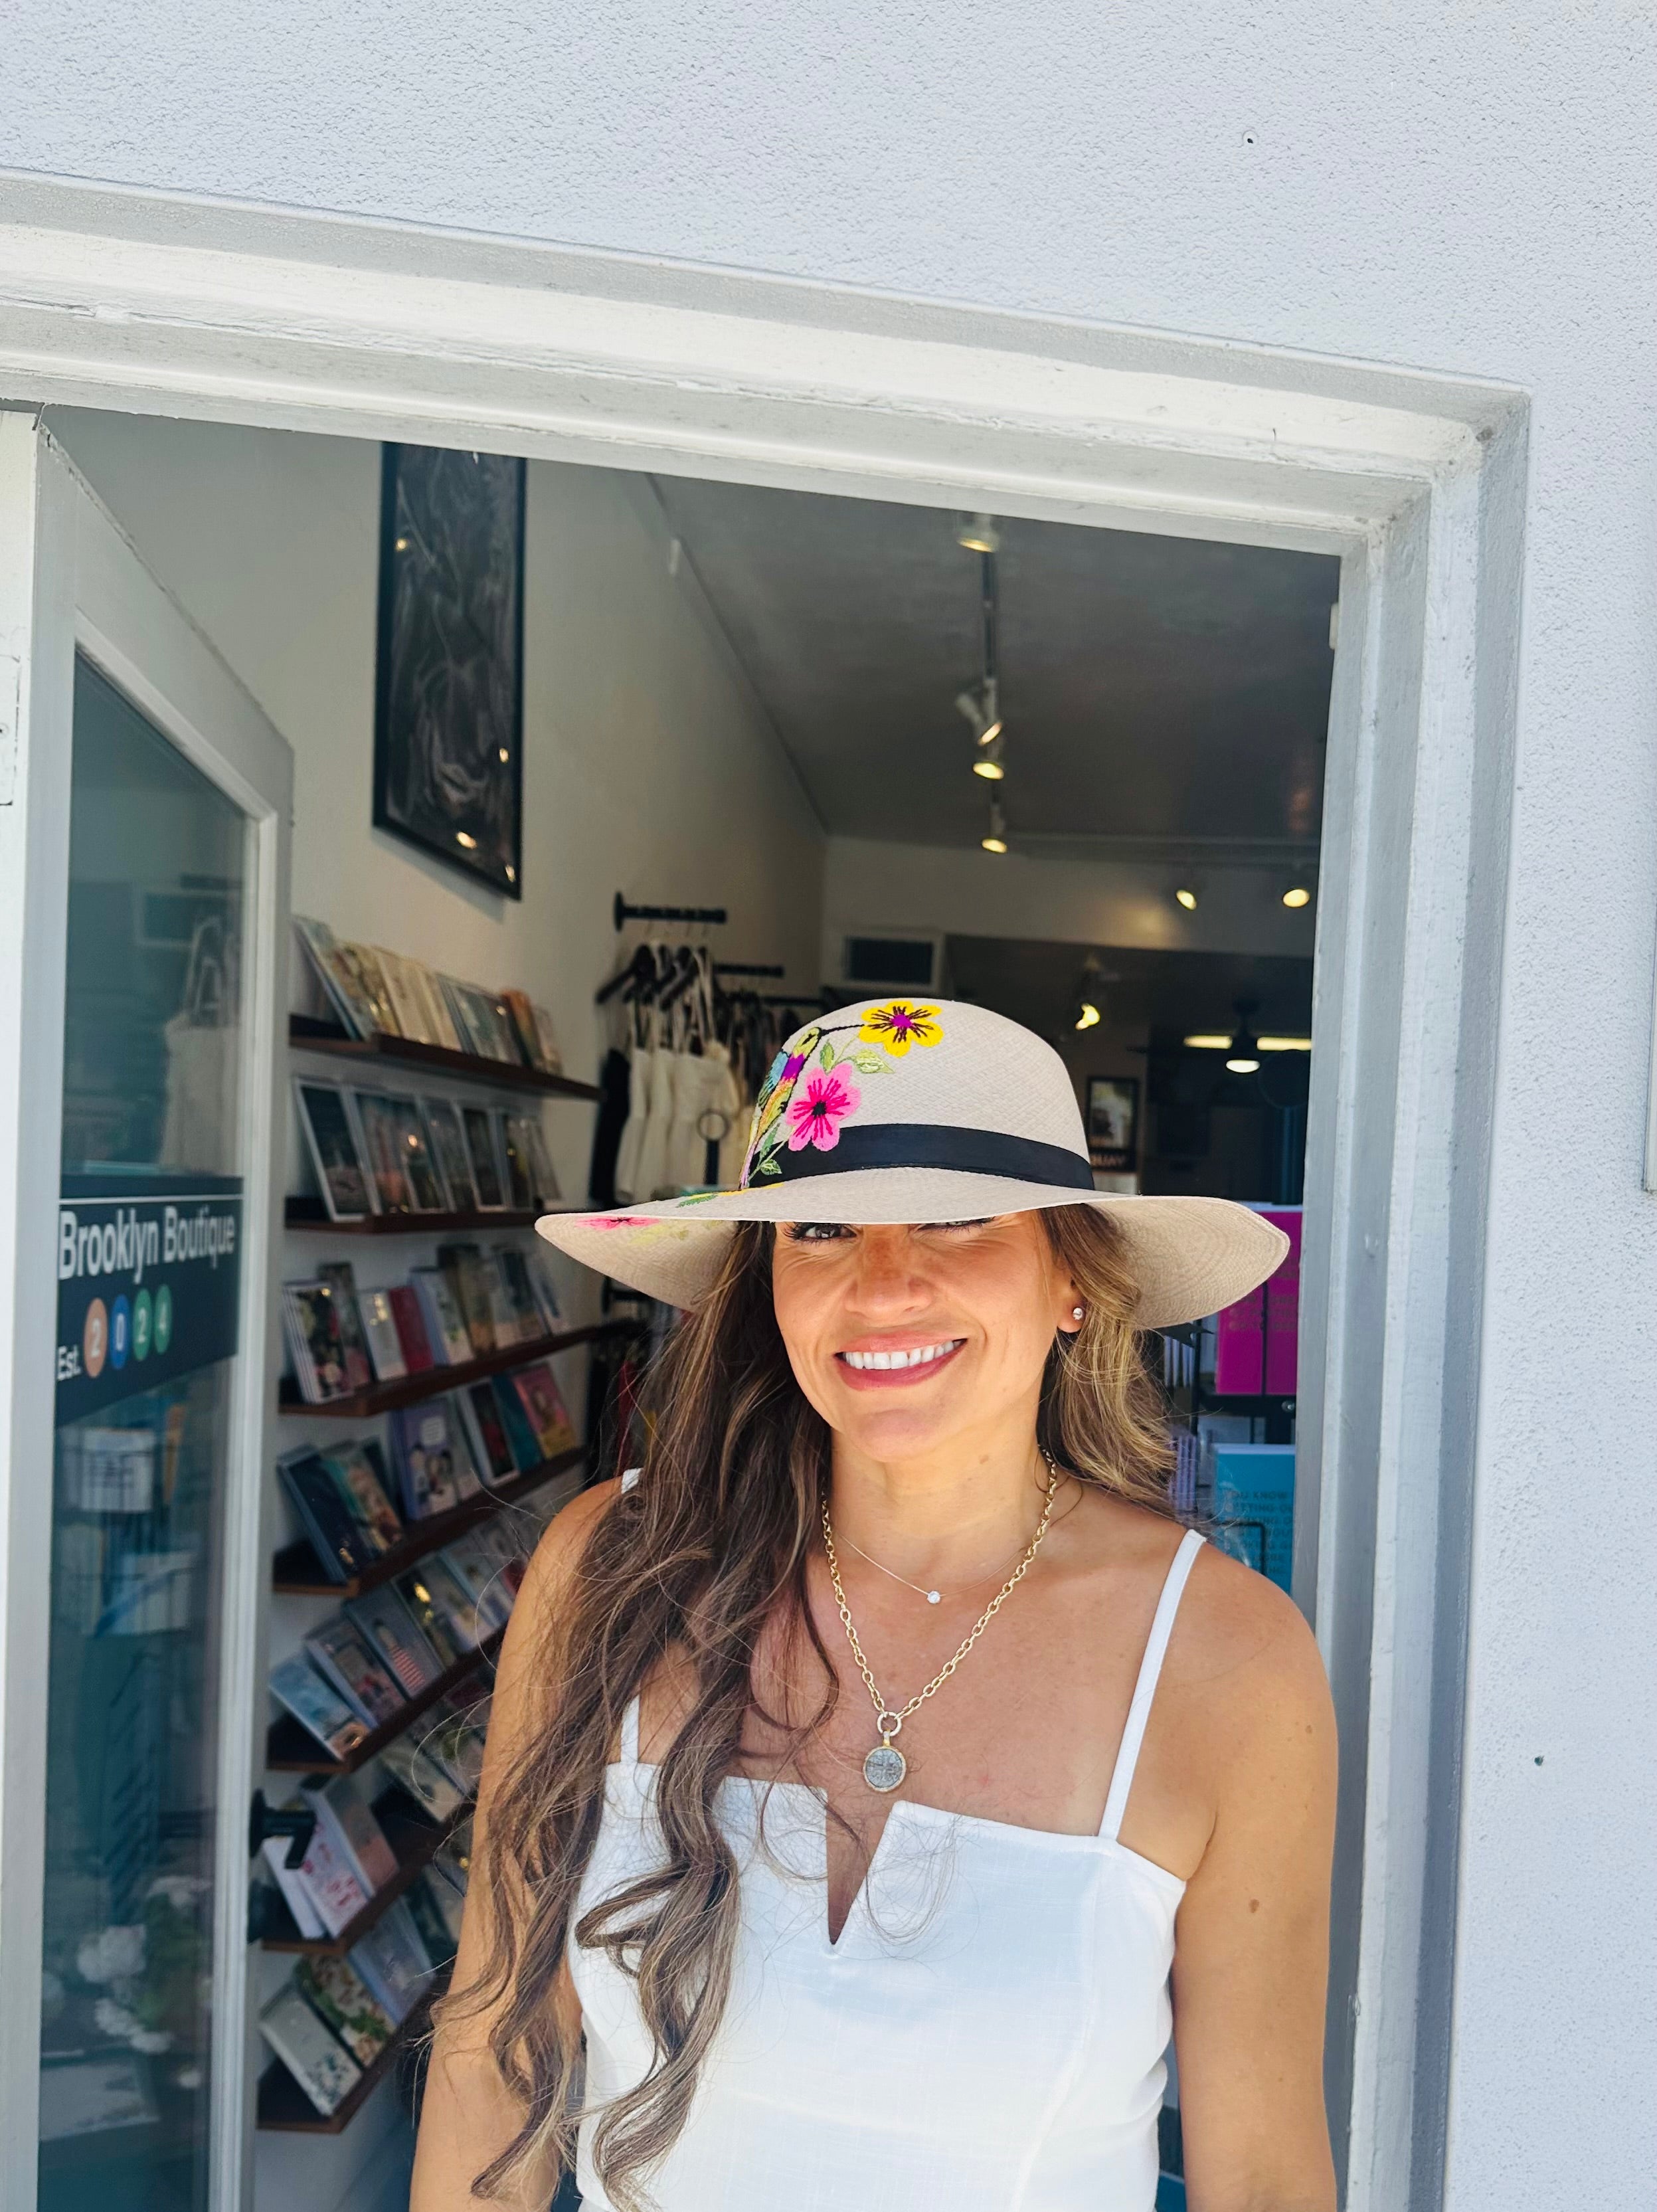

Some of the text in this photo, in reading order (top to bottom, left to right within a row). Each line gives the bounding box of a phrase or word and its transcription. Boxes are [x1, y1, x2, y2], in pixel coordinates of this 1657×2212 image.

[58, 1204, 235, 1285] Brooklyn Boutique
[1253, 1491, 1287, 1499] KNOW
